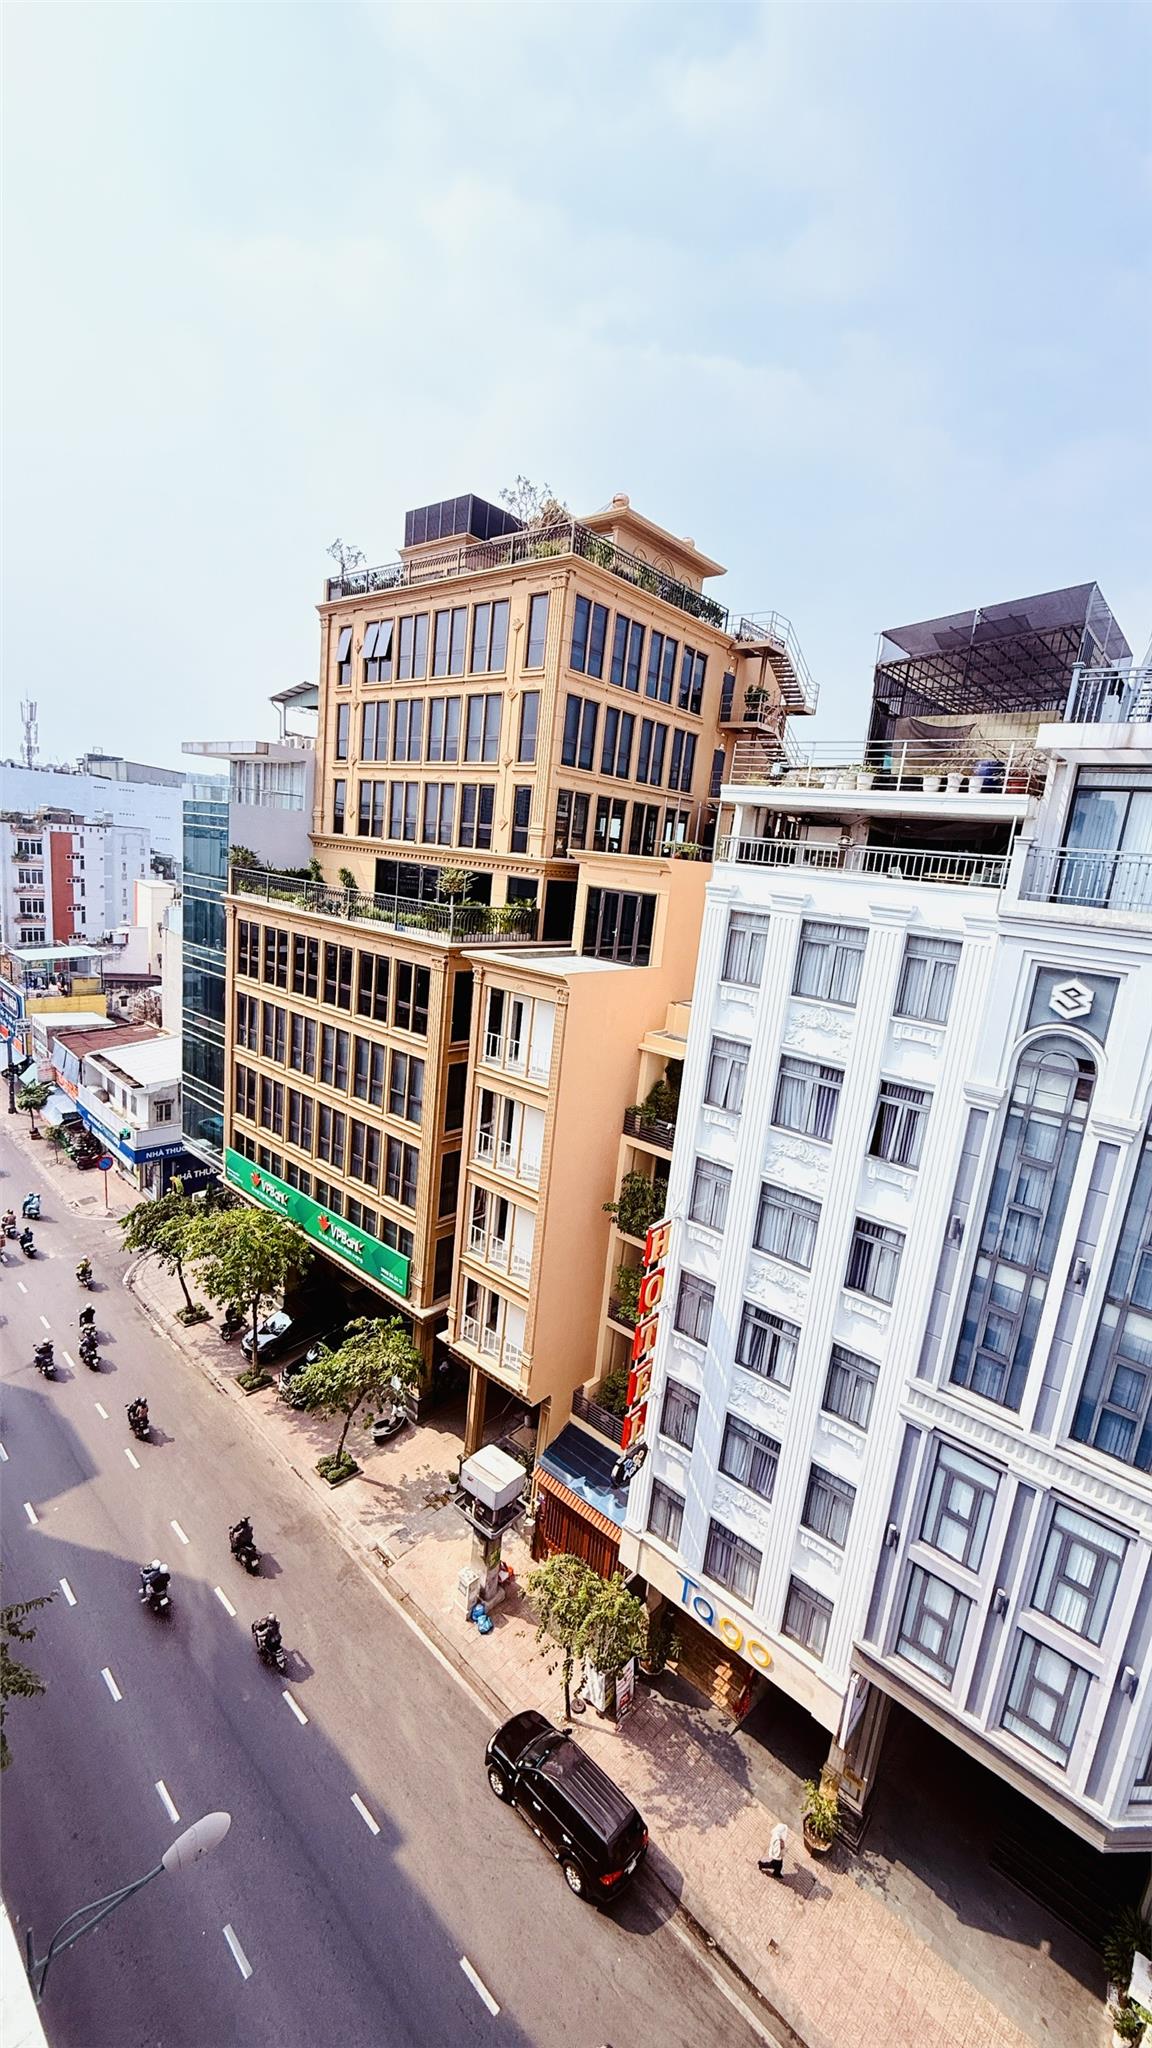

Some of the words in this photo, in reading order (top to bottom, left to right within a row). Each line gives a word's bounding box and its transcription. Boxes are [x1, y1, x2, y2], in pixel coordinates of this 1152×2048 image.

[261, 1179, 291, 1206] VPBank
[330, 1223, 365, 1255] VPBank
[627, 1222, 672, 1446] HOTEL
[676, 1570, 772, 1669] Tago
